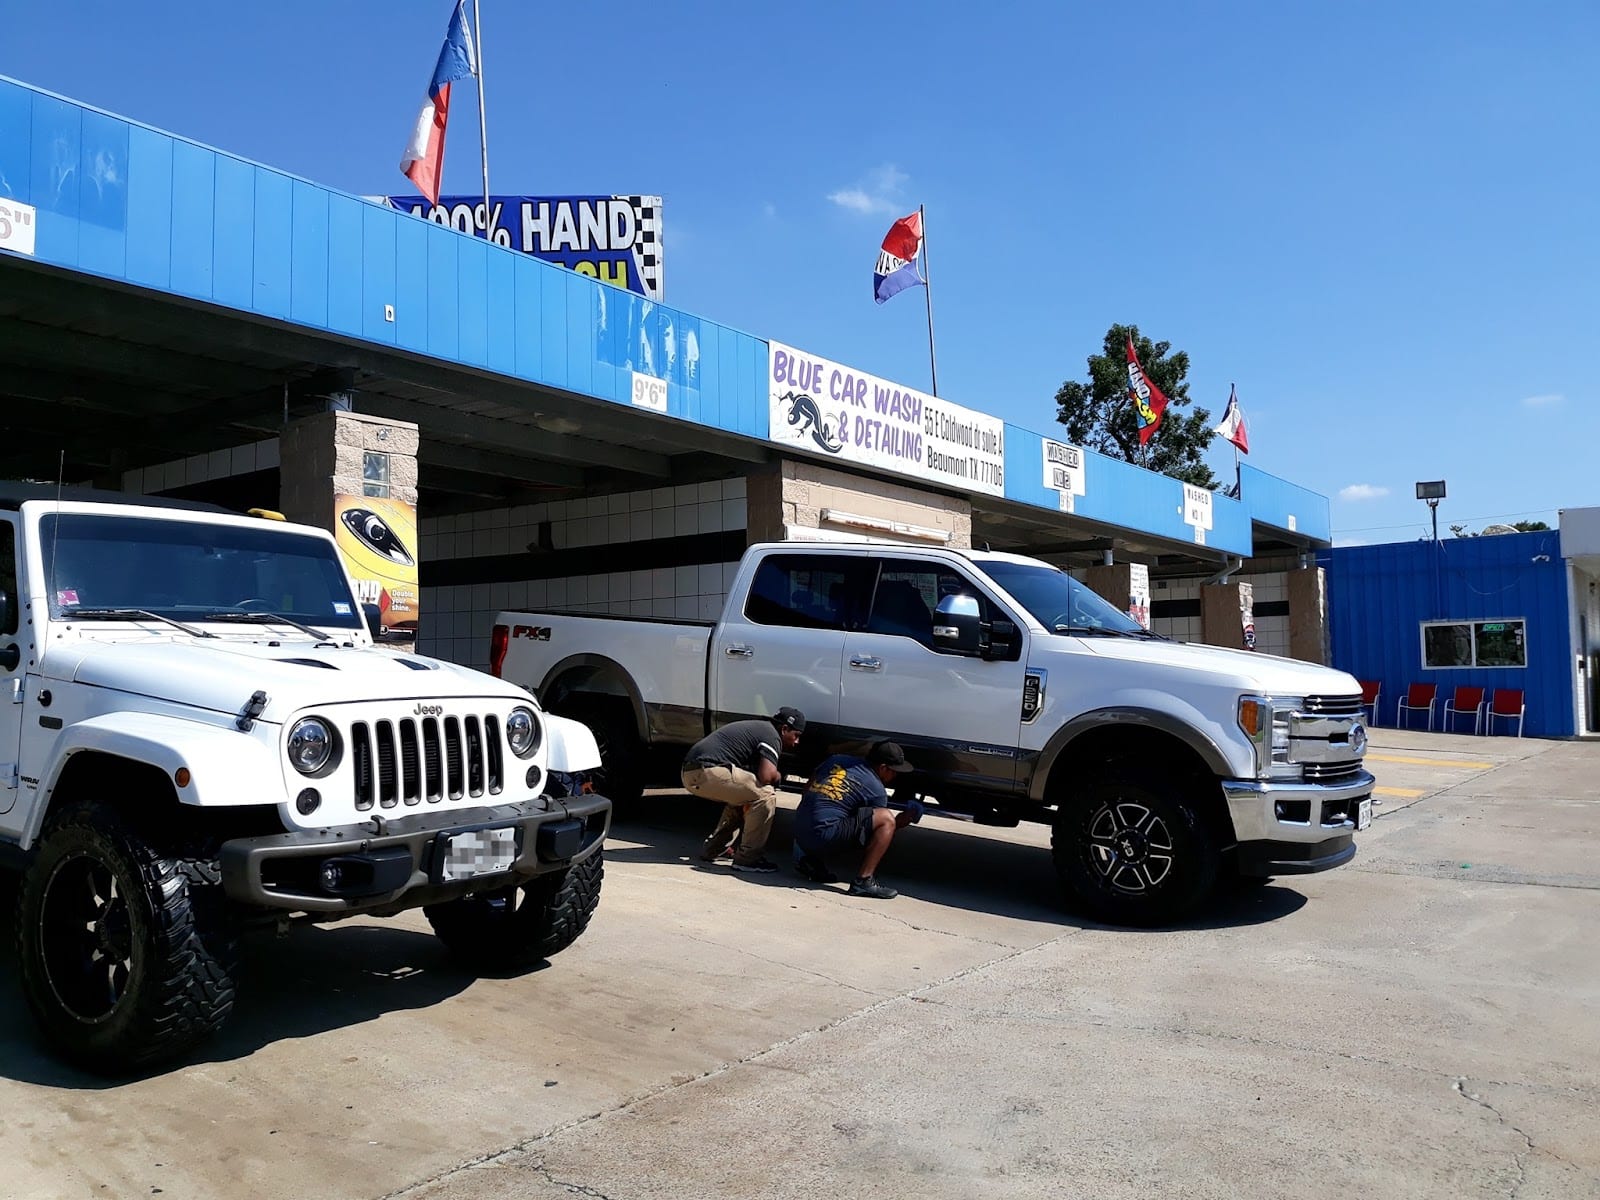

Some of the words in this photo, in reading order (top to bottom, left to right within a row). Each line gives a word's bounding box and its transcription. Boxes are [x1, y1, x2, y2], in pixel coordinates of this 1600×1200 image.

[520, 199, 638, 252] HAND
[773, 350, 824, 394] BLUE
[829, 369, 868, 409] CAR
[874, 383, 923, 426] WASH
[838, 410, 849, 443] &
[854, 415, 923, 463] DETAILING
[924, 406, 934, 436] 55
[935, 410, 939, 438] E
[940, 412, 973, 448] Coldwood
[998, 430, 1003, 457] A
[927, 445, 968, 478] Beaumont
[969, 457, 979, 481] TX
[980, 460, 1003, 487] 77706
[1047, 443, 1079, 469] WASHED
[512, 624, 551, 641] FX4
[413, 702, 444, 718] Jeep
